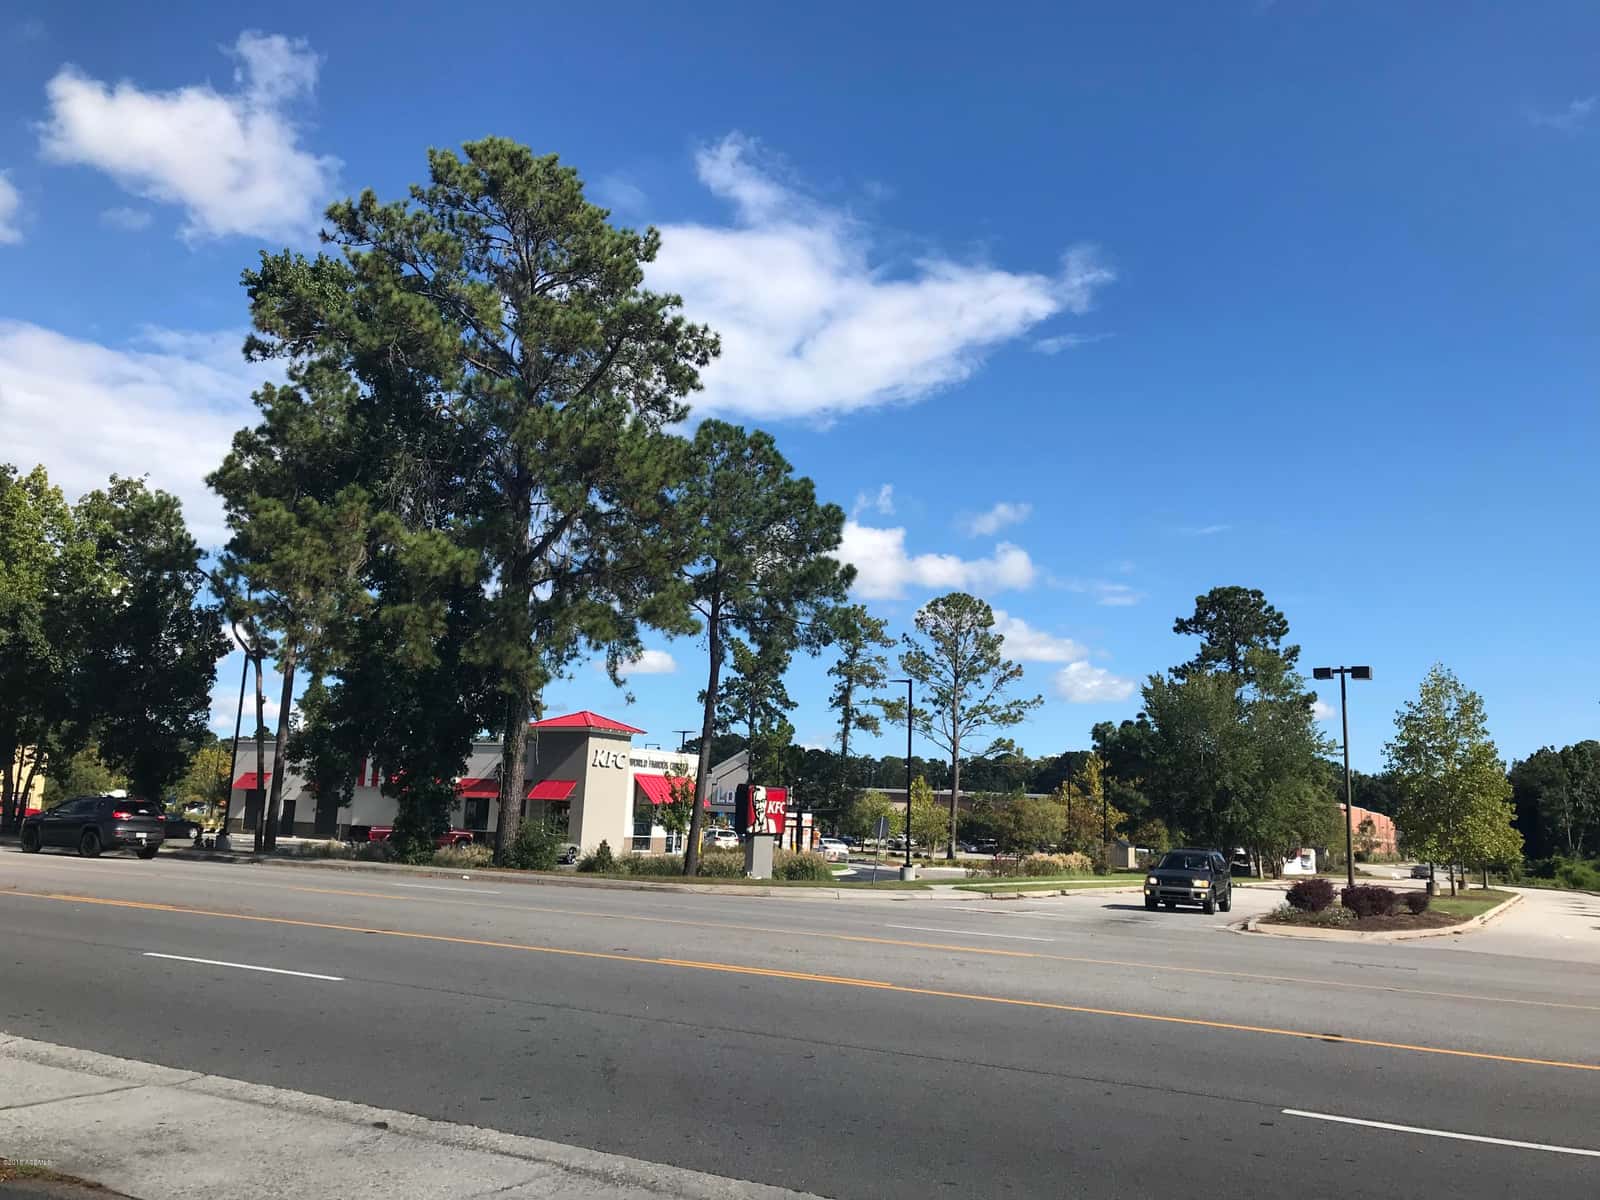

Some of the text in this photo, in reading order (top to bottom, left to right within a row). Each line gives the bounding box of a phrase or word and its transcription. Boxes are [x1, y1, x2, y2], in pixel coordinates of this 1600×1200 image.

[592, 748, 626, 769] KFC
[629, 758, 648, 769] WORLD
[767, 800, 786, 815] KFC
